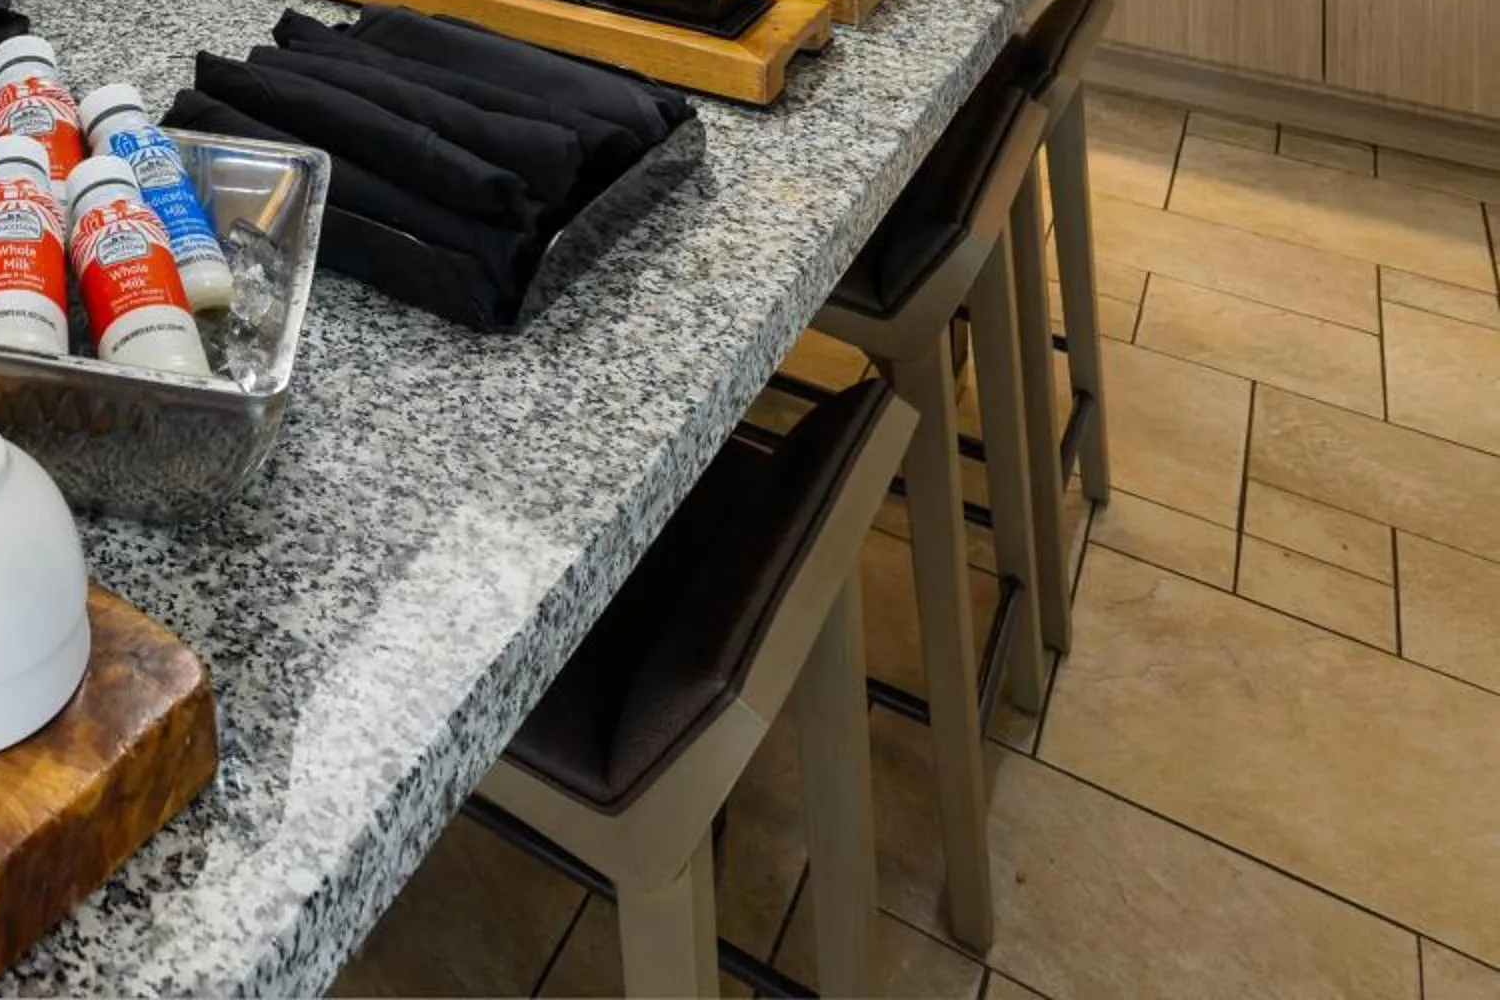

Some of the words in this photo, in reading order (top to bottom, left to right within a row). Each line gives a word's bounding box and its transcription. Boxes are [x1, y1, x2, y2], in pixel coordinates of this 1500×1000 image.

[3, 257, 31, 270] Milk
[110, 264, 149, 281] Whole
[120, 278, 147, 292] Milk
